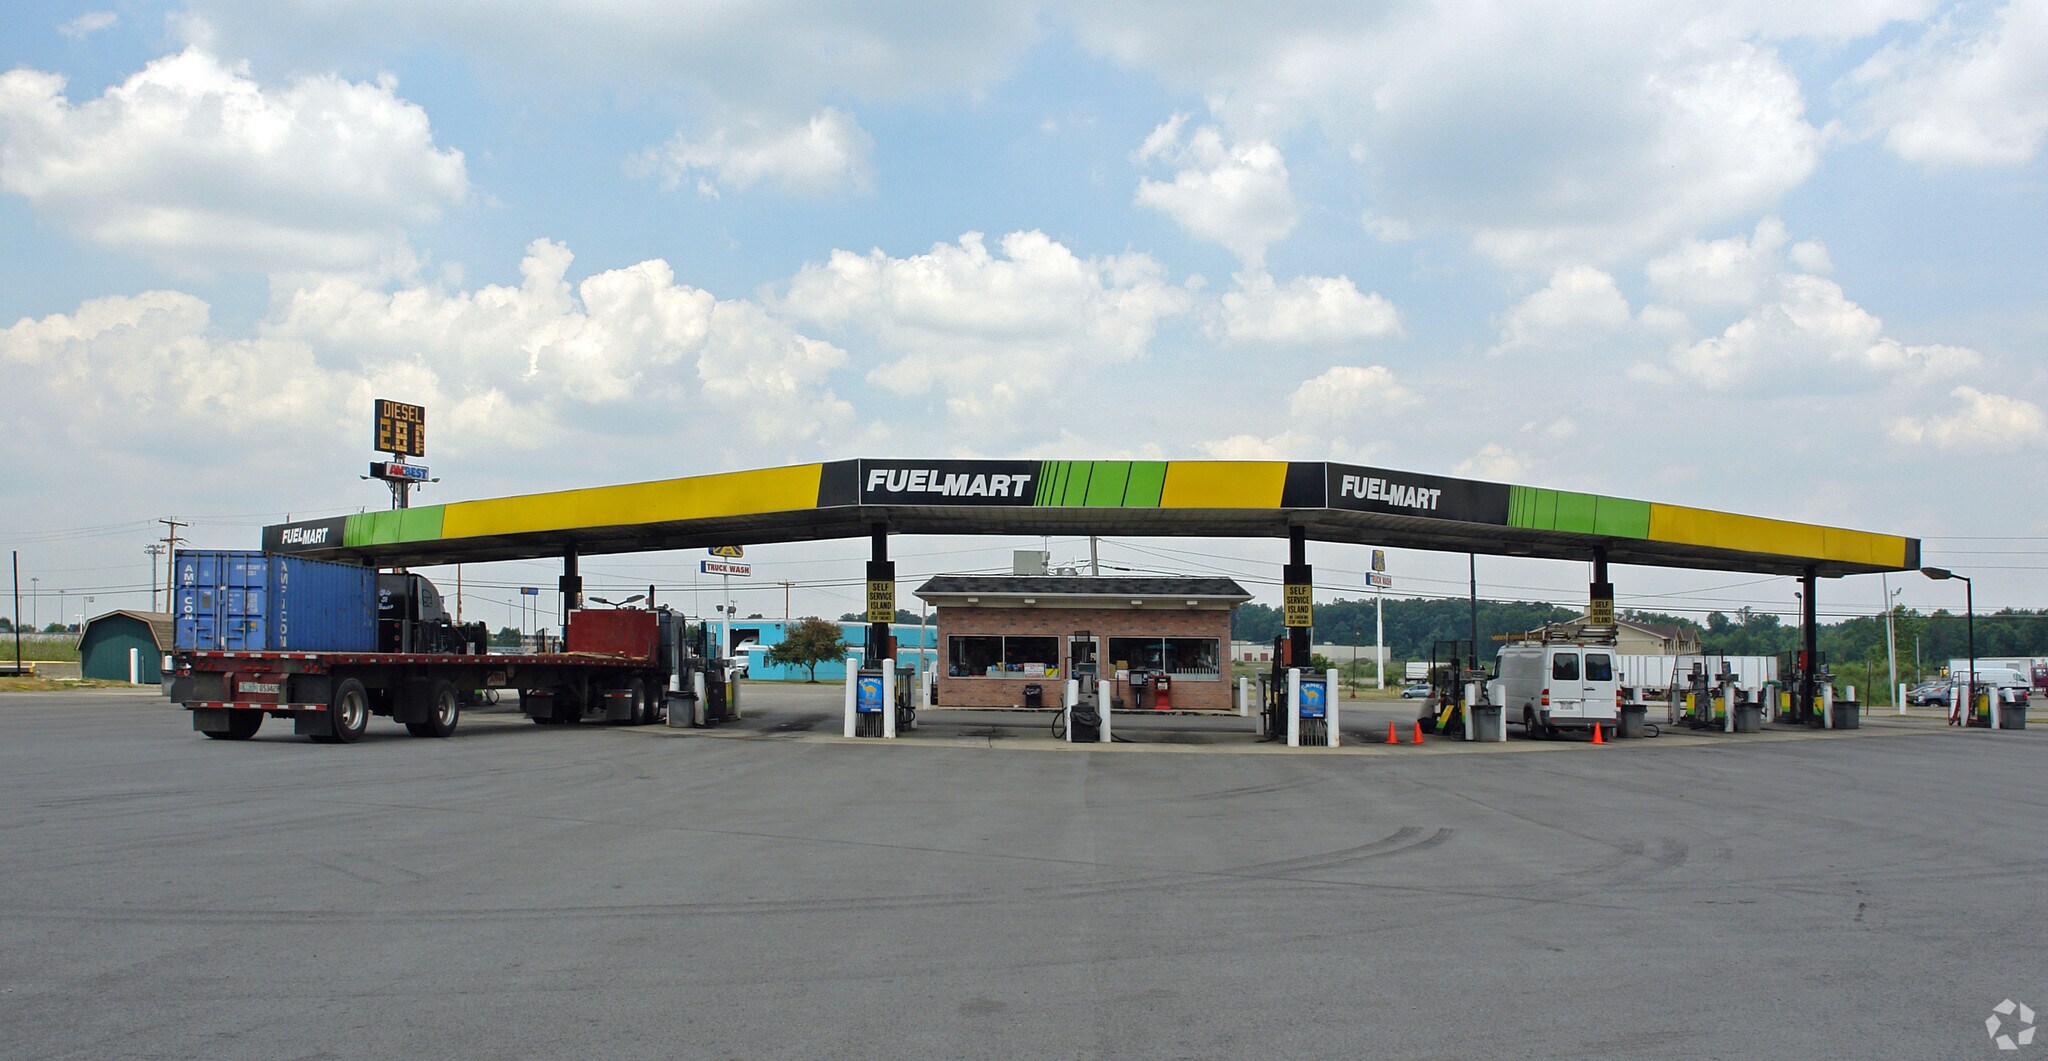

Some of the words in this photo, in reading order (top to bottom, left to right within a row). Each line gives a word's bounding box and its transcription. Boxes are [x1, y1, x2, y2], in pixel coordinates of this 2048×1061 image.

[383, 401, 422, 423] DIESEL
[866, 469, 1032, 497] FUELMART
[1341, 474, 1442, 510] FUELMART
[281, 527, 329, 545] FUELMART
[707, 563, 728, 572] TRUCK
[729, 564, 750, 574] WASH
[872, 583, 889, 591] SELF
[1289, 586, 1307, 595] SELF
[869, 592, 893, 600] SERVICE
[1286, 595, 1310, 604] SERVICE
[870, 601, 892, 609] ISLAND
[1287, 605, 1309, 614] ISLAND
[1593, 608, 1612, 616] SERVICE
[1593, 616, 1611, 624] ISLAND
[859, 677, 882, 685] CAMEL
